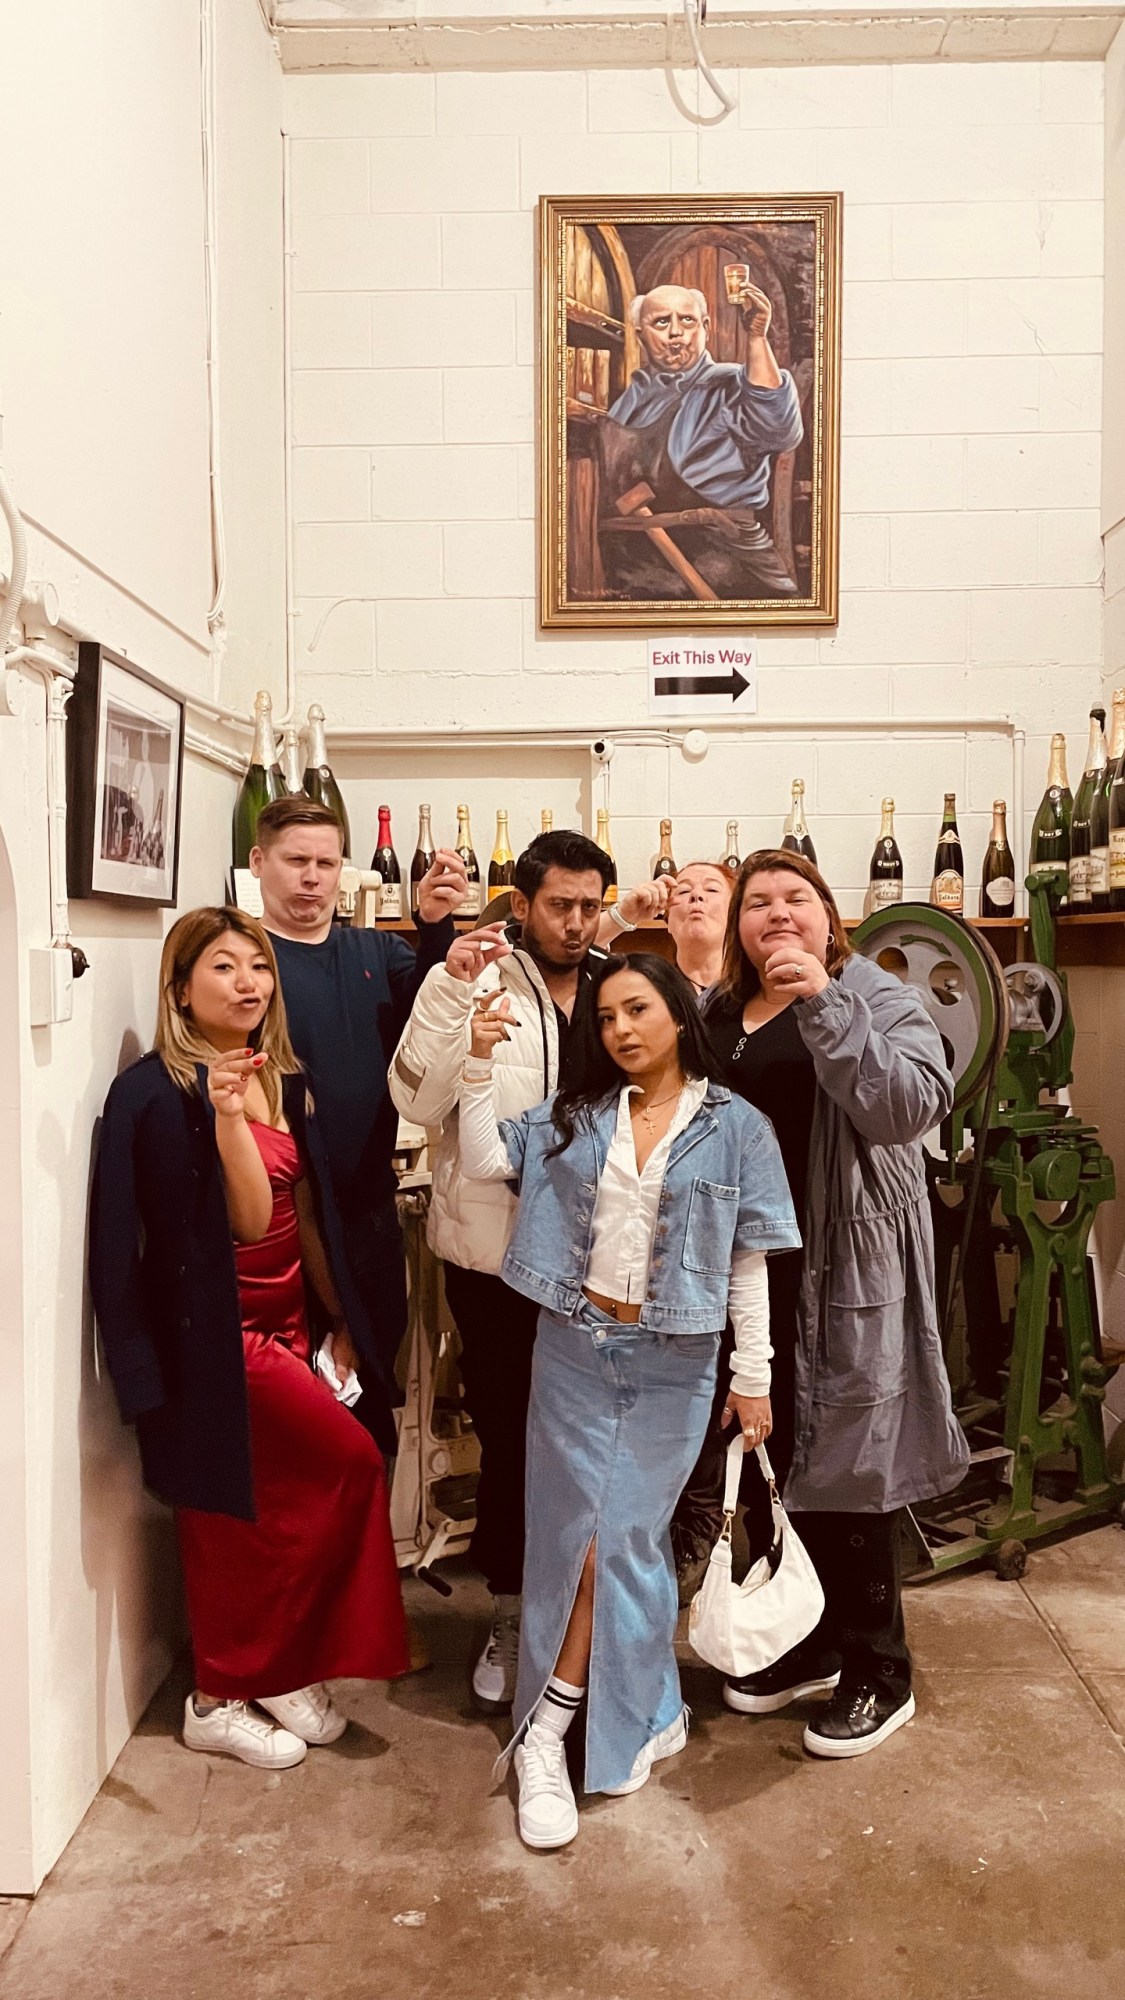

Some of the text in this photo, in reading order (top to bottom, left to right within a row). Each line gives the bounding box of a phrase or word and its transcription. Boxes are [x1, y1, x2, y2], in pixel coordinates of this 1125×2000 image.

[652, 649, 752, 666] Exit This Way
